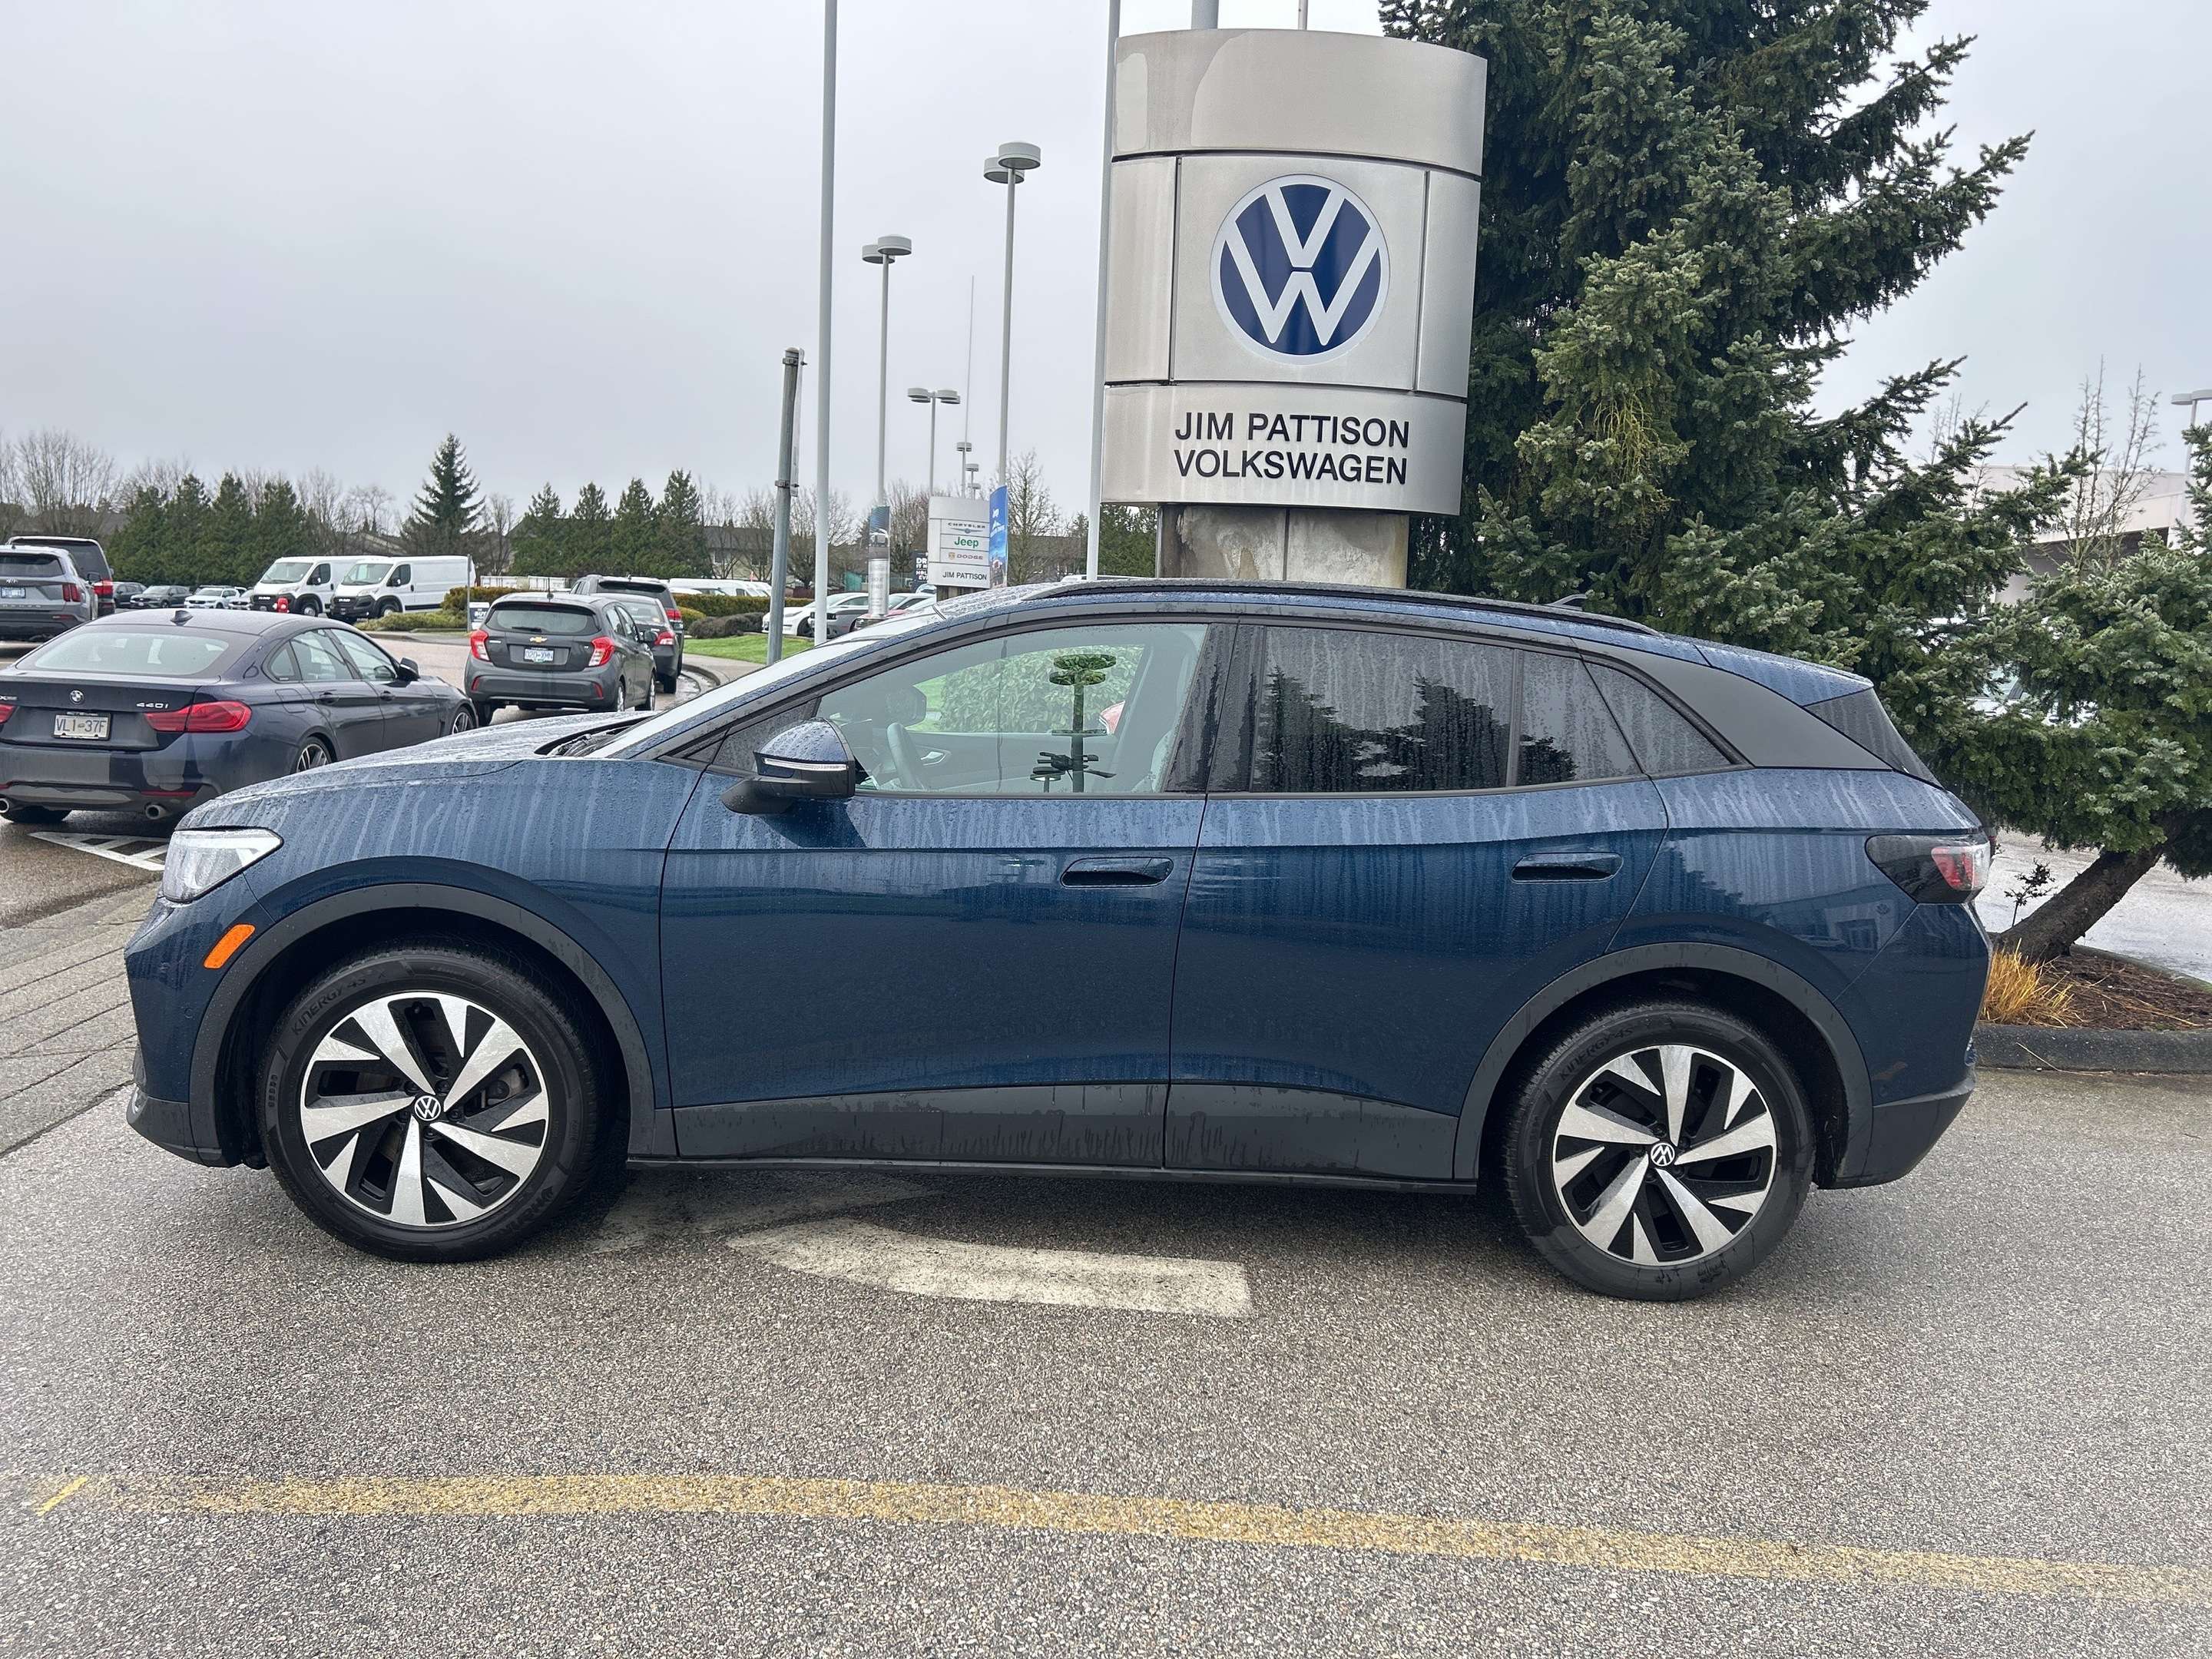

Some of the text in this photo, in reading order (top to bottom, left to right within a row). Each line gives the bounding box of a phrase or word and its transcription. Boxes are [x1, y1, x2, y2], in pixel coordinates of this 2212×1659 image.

[1175, 412, 1409, 449] JIM PATTISON
[1174, 449, 1407, 485] VOLKSWAGEN
[954, 536, 979, 548] Jeep
[956, 572, 987, 581] PATTISON
